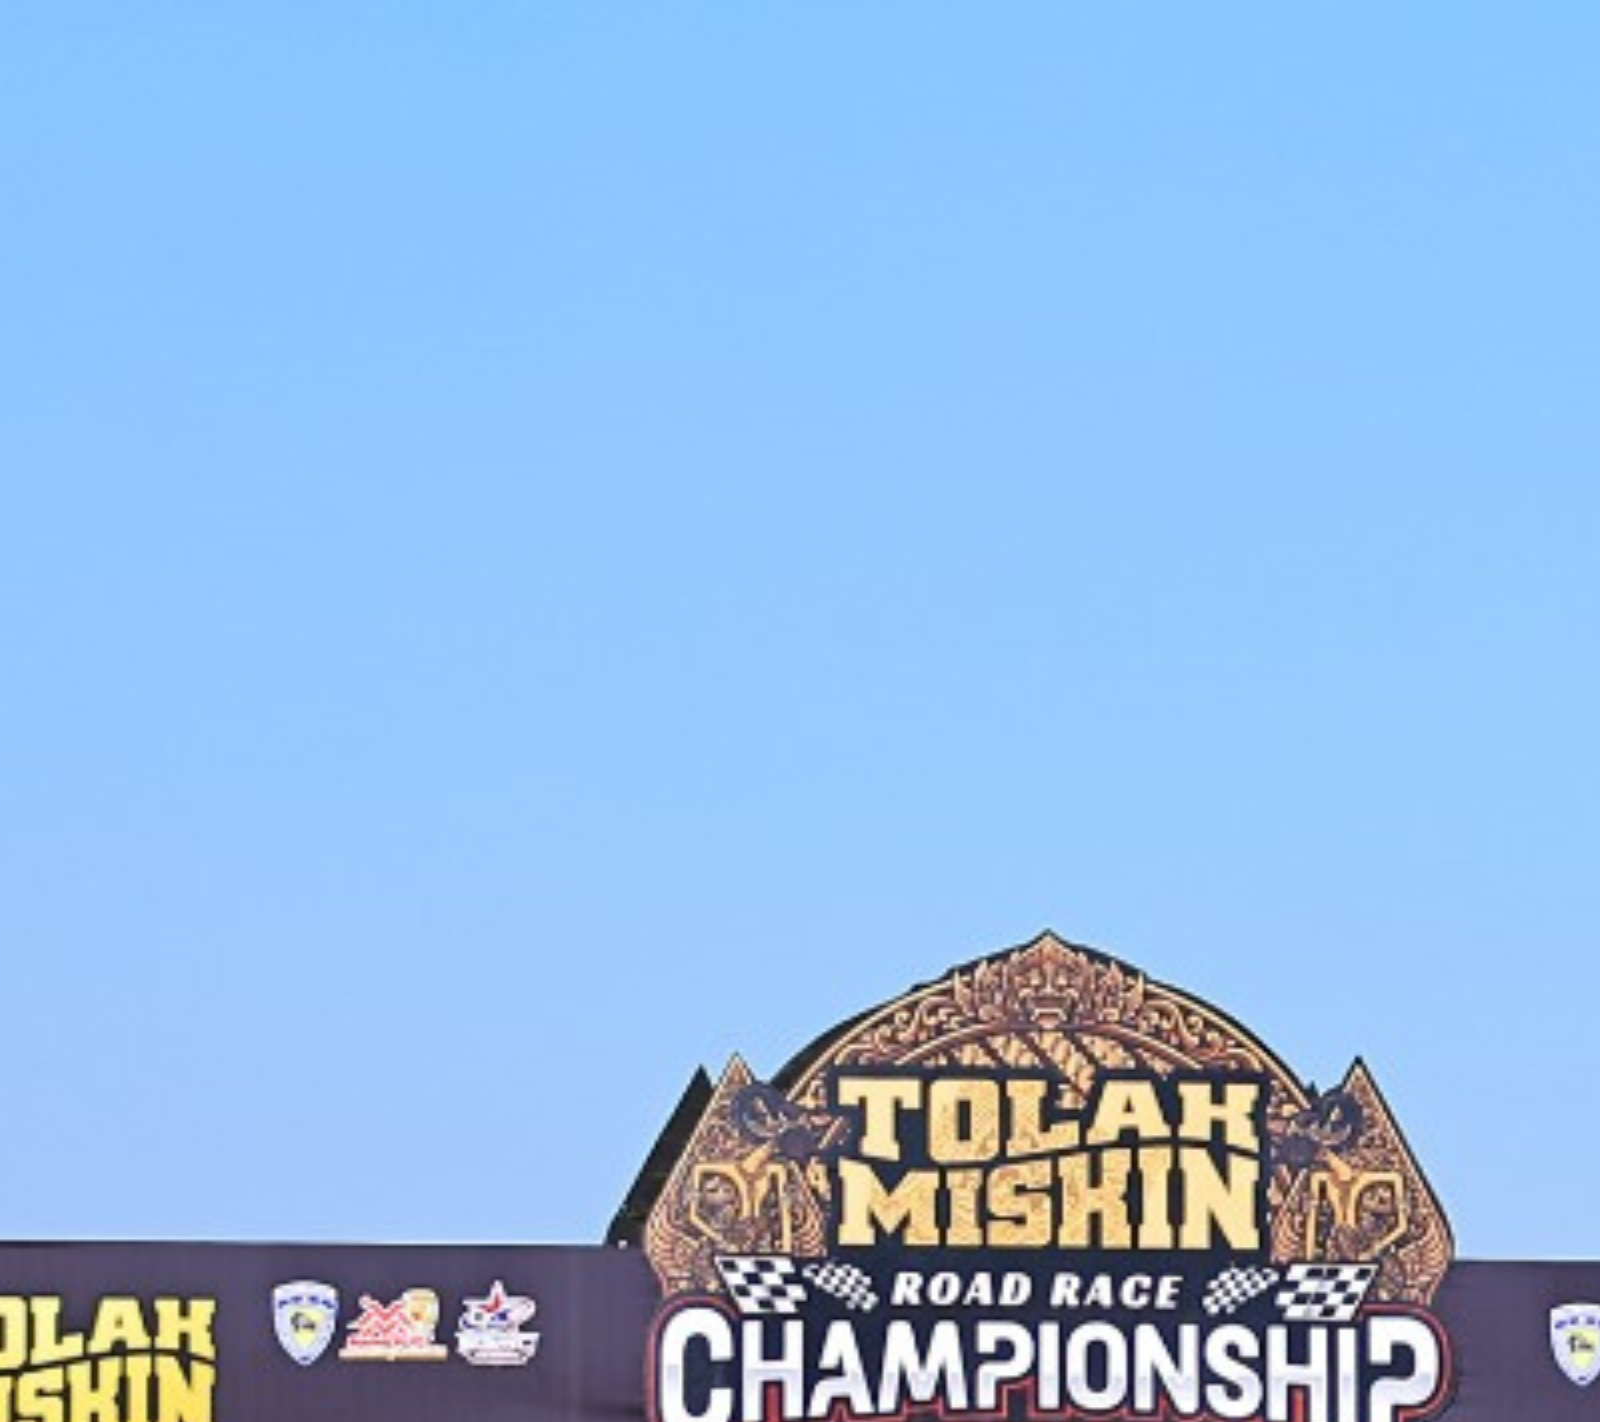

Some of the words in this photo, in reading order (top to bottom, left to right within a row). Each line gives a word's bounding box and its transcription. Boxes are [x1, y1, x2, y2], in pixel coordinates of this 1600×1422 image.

[837, 1077, 1261, 1162] TOLAK
[837, 1146, 1261, 1250] MISKIN
[891, 1271, 1040, 1309] ROAD
[1050, 1273, 1184, 1311] RACE
